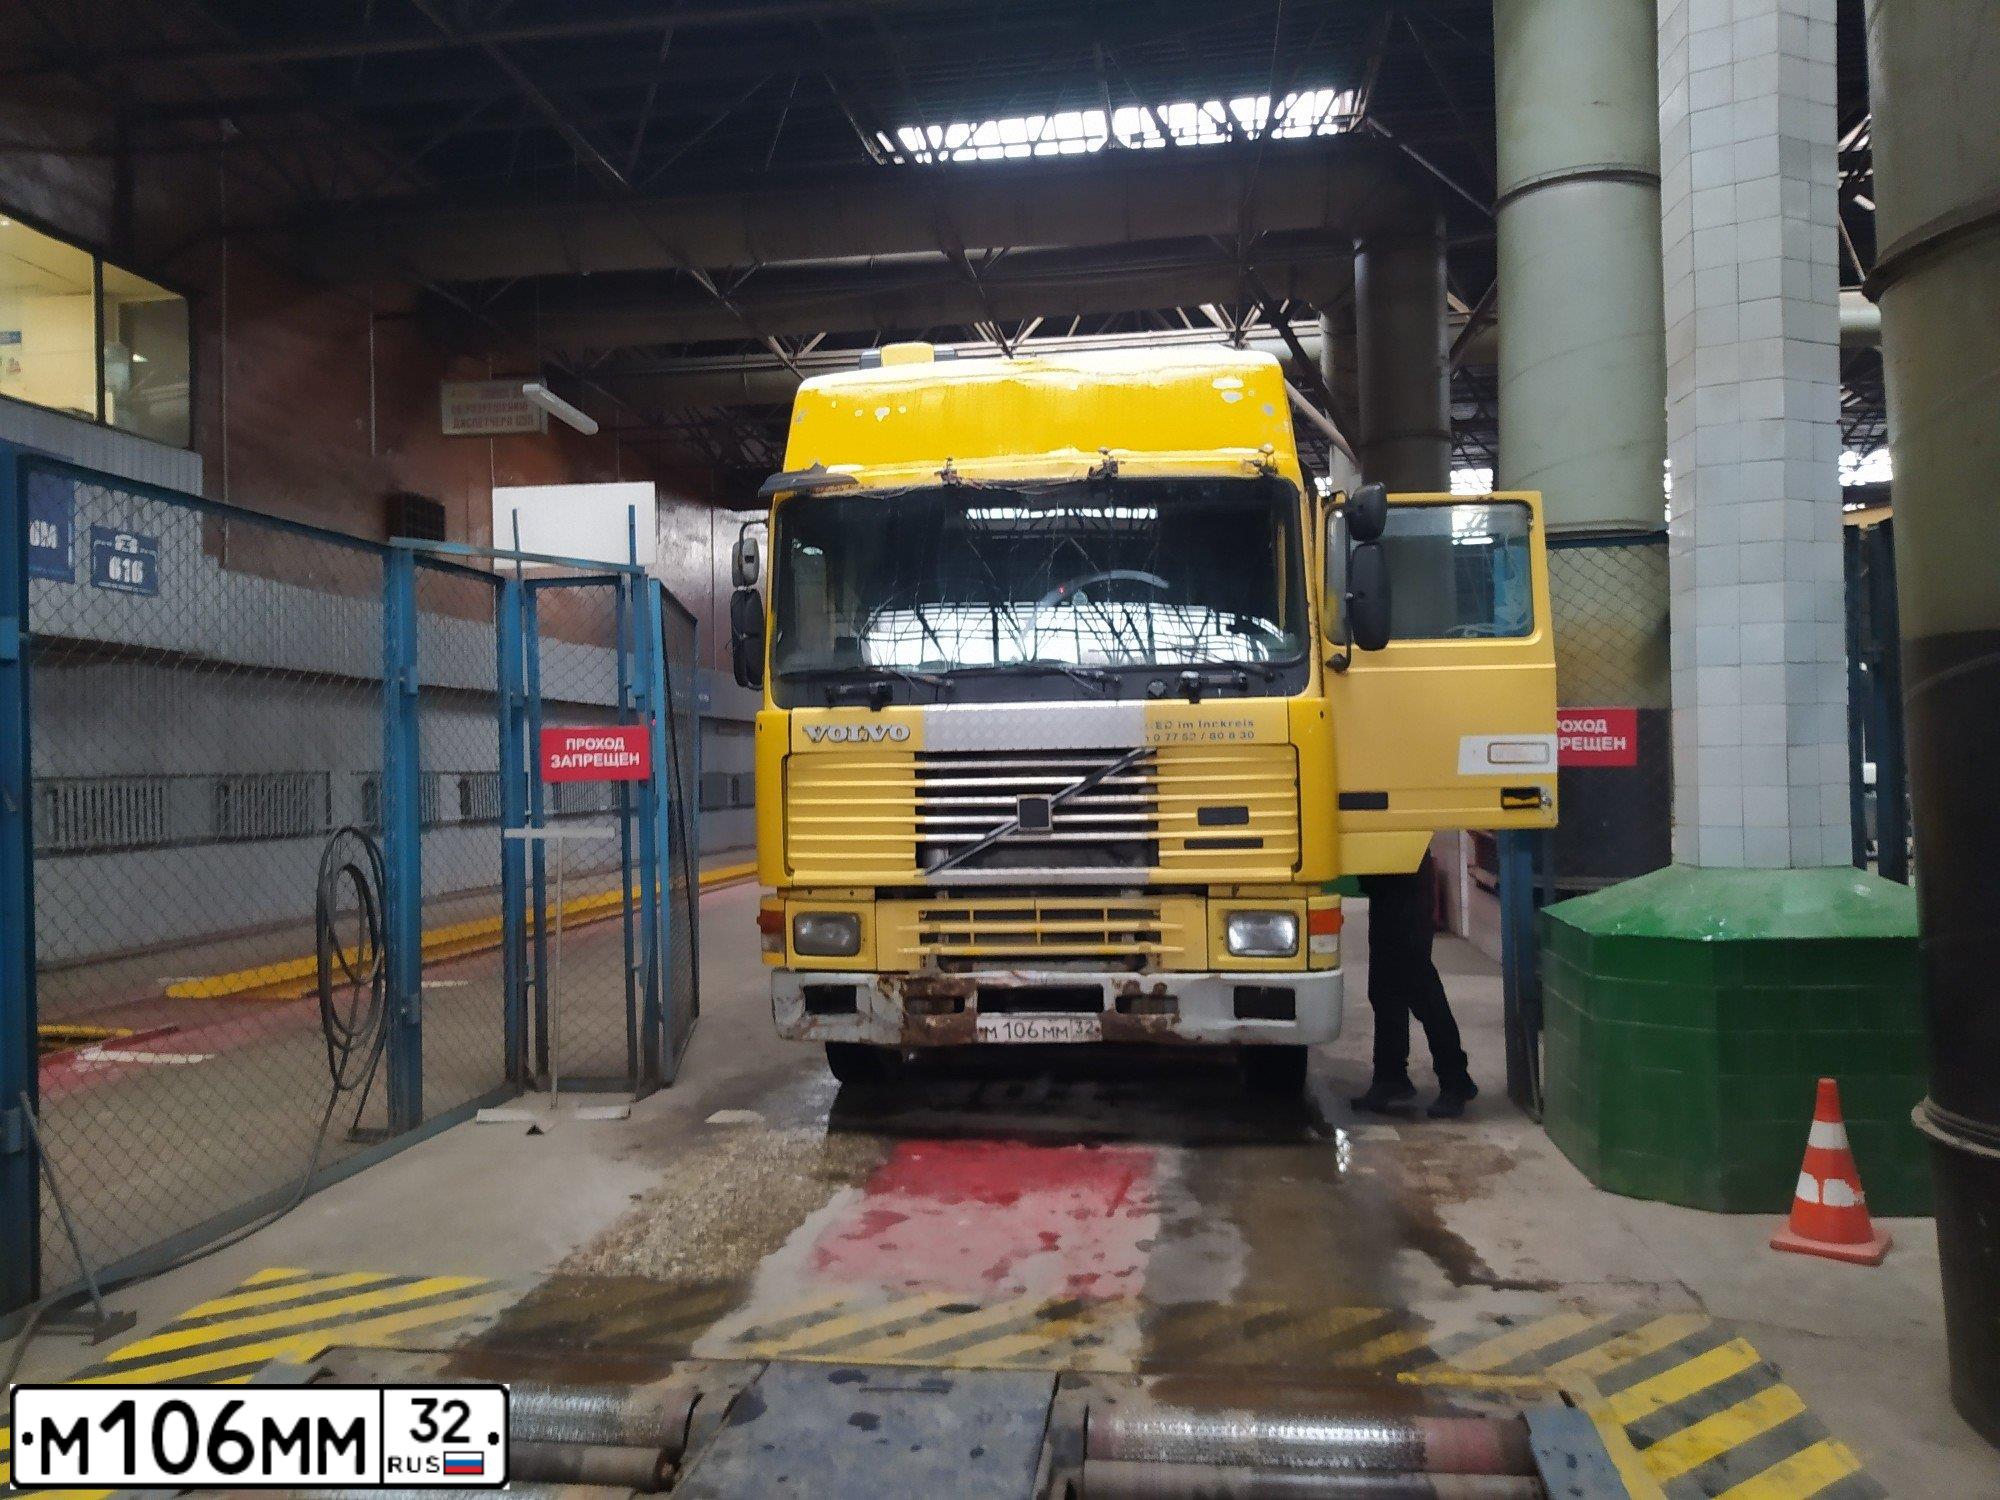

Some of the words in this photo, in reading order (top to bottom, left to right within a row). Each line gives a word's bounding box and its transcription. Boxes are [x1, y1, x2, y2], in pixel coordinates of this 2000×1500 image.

[802, 725, 910, 743] VOLVO
[566, 737, 625, 752] ПРОХОД
[1559, 736, 1626, 752] РЕЩЕН
[550, 752, 640, 768] ЗАПРЕЩЕН
